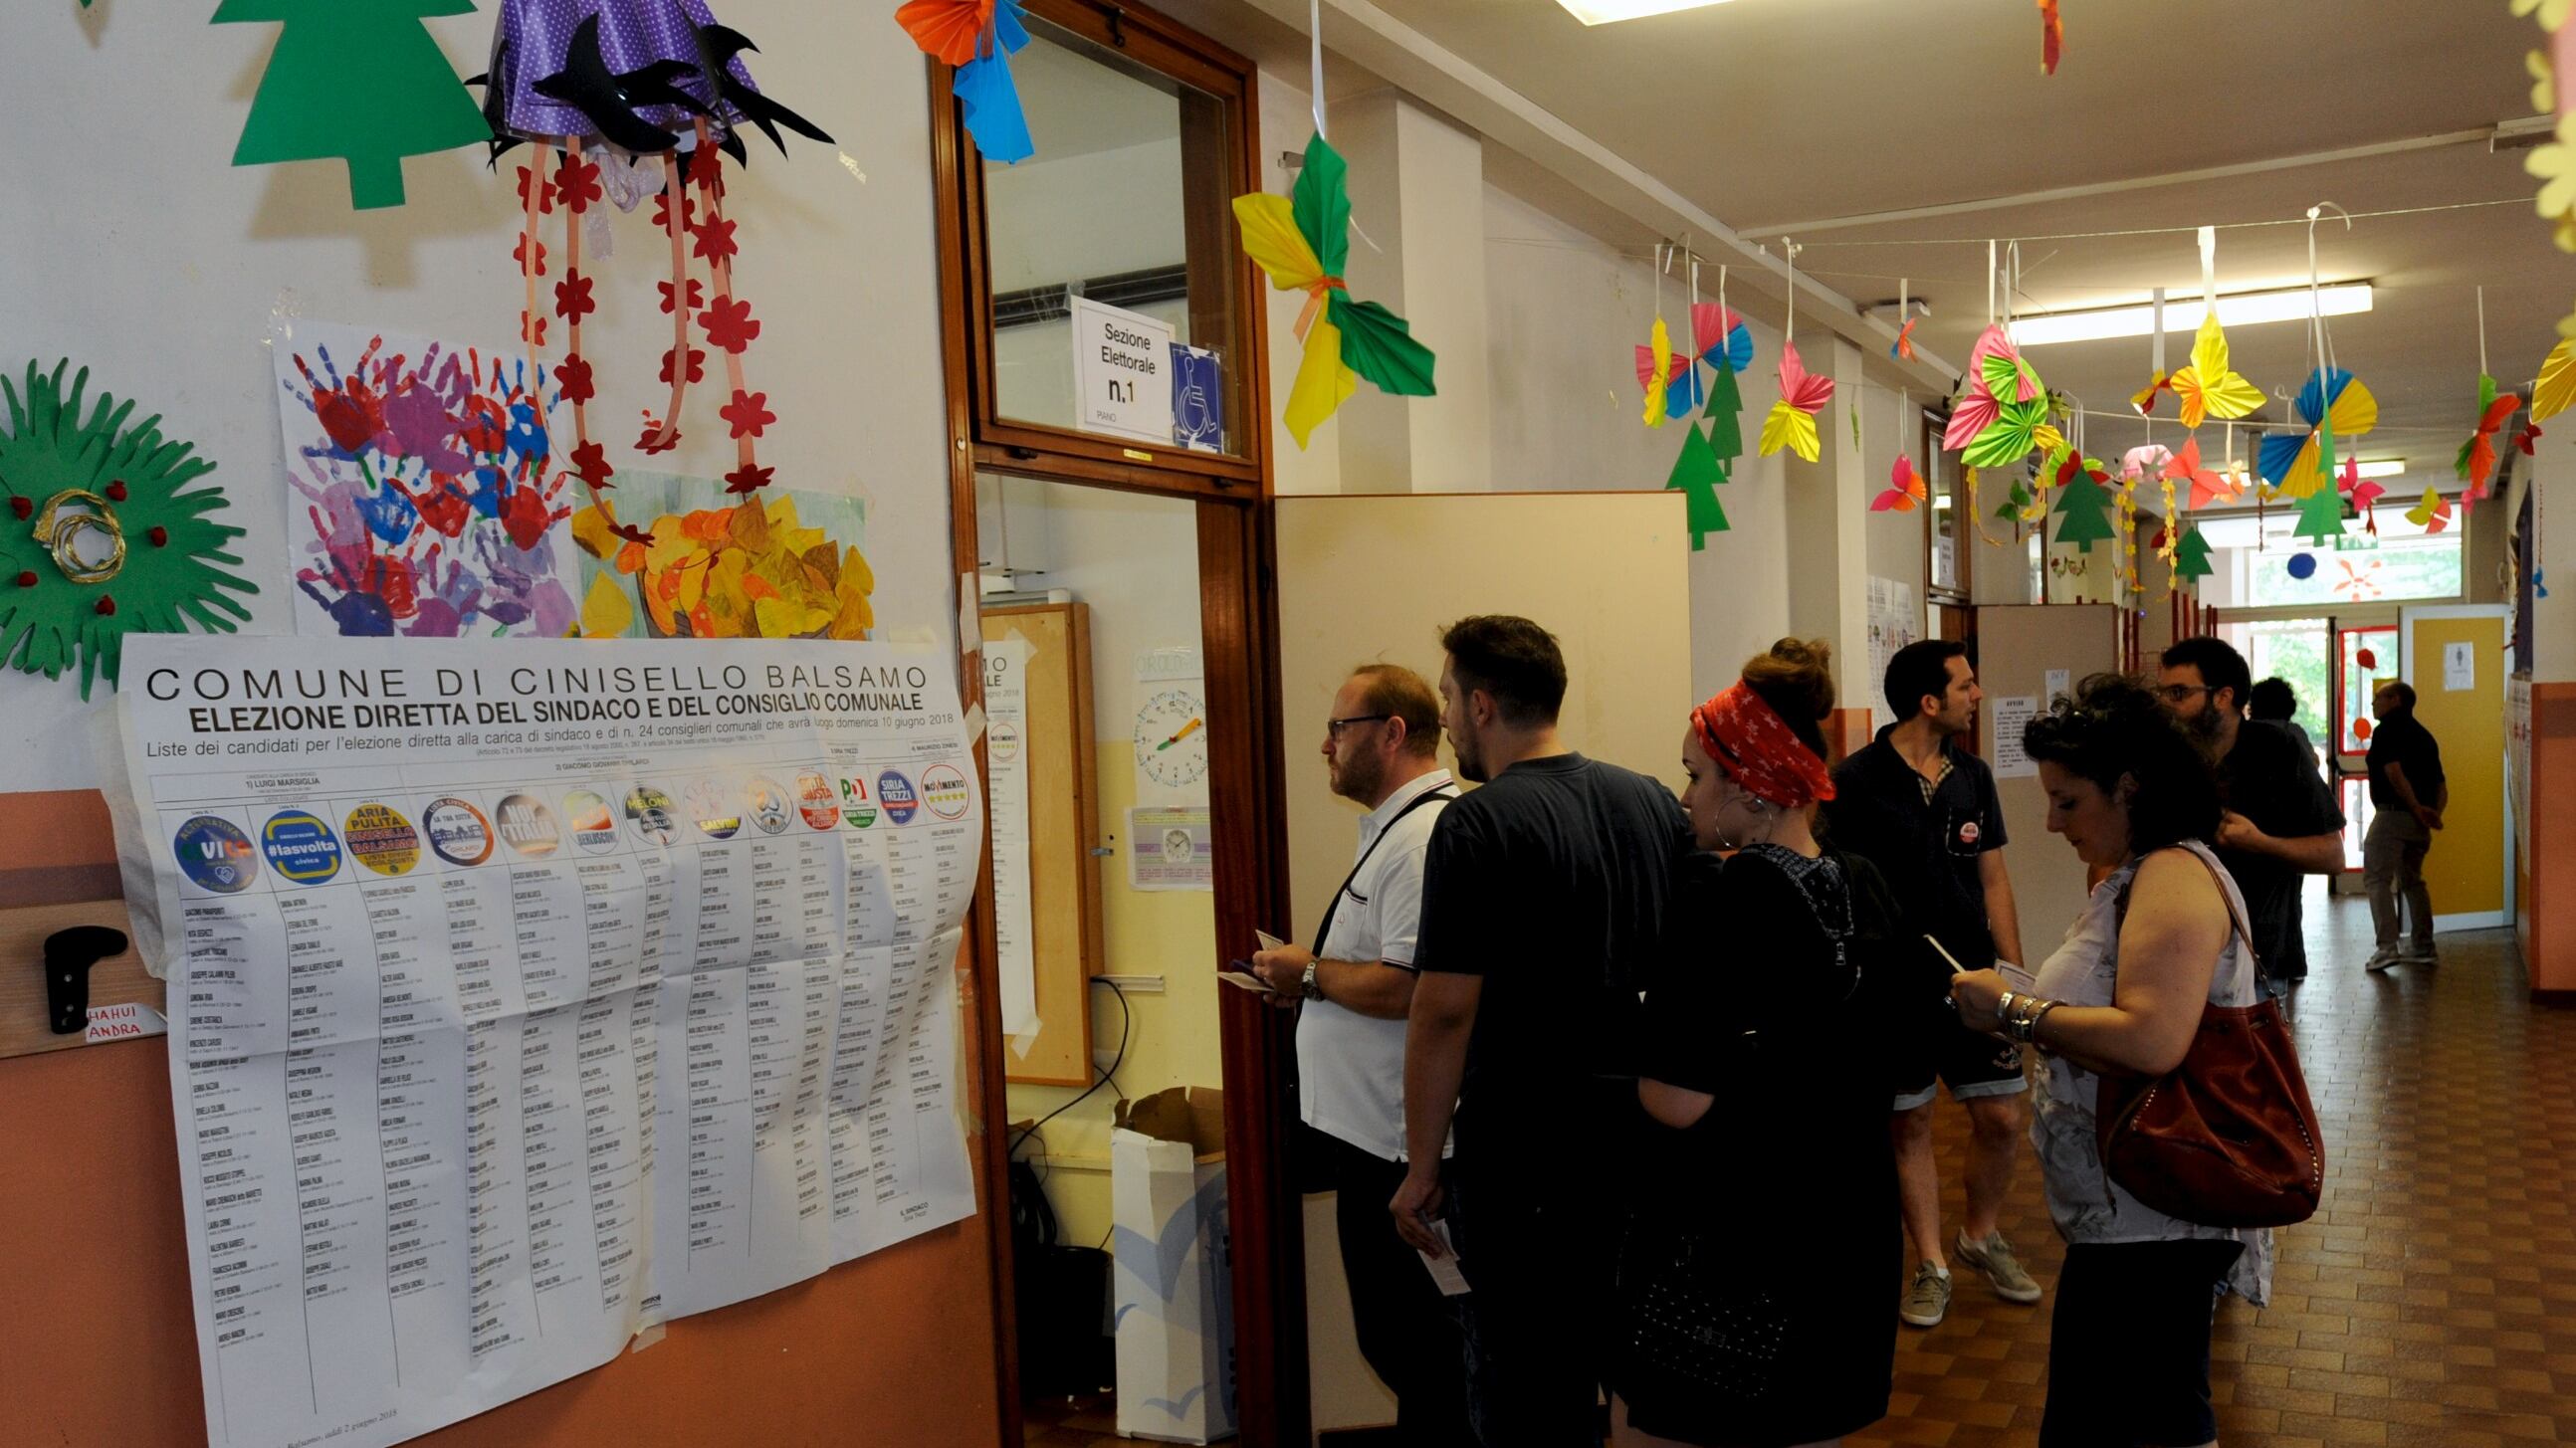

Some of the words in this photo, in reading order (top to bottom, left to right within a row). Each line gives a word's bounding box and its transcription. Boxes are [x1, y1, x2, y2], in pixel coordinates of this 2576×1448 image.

[1104, 322, 1151, 350] Sezione
[1101, 345, 1156, 375] Elettorale
[1096, 410, 1116, 423] PIANO
[146, 668, 407, 701] COMUNE
[436, 669, 482, 697] DI
[511, 665, 747, 697] CINISELLO
[766, 665, 927, 689] BALSAMO
[189, 705, 346, 732] ELEZIONE
[353, 703, 470, 728] DIRETTA
[476, 702, 528, 724] DEL
[534, 698, 640, 724] SINDACO
[648, 698, 662, 719] E
[668, 697, 711, 718] DEL
[716, 693, 821, 715] CONSIGLIO
[824, 694, 924, 712] COMUNALE
[146, 741, 187, 757] Liste
[195, 740, 220, 755] dei
[227, 737, 299, 754] candidati
[306, 738, 330, 754] per
[336, 735, 402, 751] l'elezione
[408, 733, 452, 748] diretta
[457, 731, 479, 745] alla
[485, 730, 523, 745] carica
[528, 728, 539, 742] di
[543, 728, 591, 742] sindaco
[595, 729, 603, 739] e
[608, 726, 619, 738] di
[623, 726, 634, 738] n.
[638, 724, 653, 737] 24
[658, 722, 712, 737] consiglieri
[716, 720, 762, 733] comunali
[766, 719, 784, 730] che
[787, 717, 811, 729] avrà
[836, 717, 879, 728] domenica
[882, 716, 892, 726] 10
[895, 716, 926, 729] giugno
[929, 714, 954, 725] 2018
[255, 779, 276, 788] LUIGI
[277, 776, 321, 786] MARSIGLIA
[881, 779, 906, 790] SIRIA
[924, 778, 965, 792] MOVIMENTO
[881, 789, 913, 801] TREZZI
[627, 796, 670, 811] MELONI
[357, 806, 389, 818] ARIA
[350, 816, 401, 829] PULITA
[700, 817, 740, 831] SALVINI
[268, 840, 336, 857] #lasvolta
[90, 1023, 141, 1037] ANDRA
[378, 1409, 399, 1421] 2018
